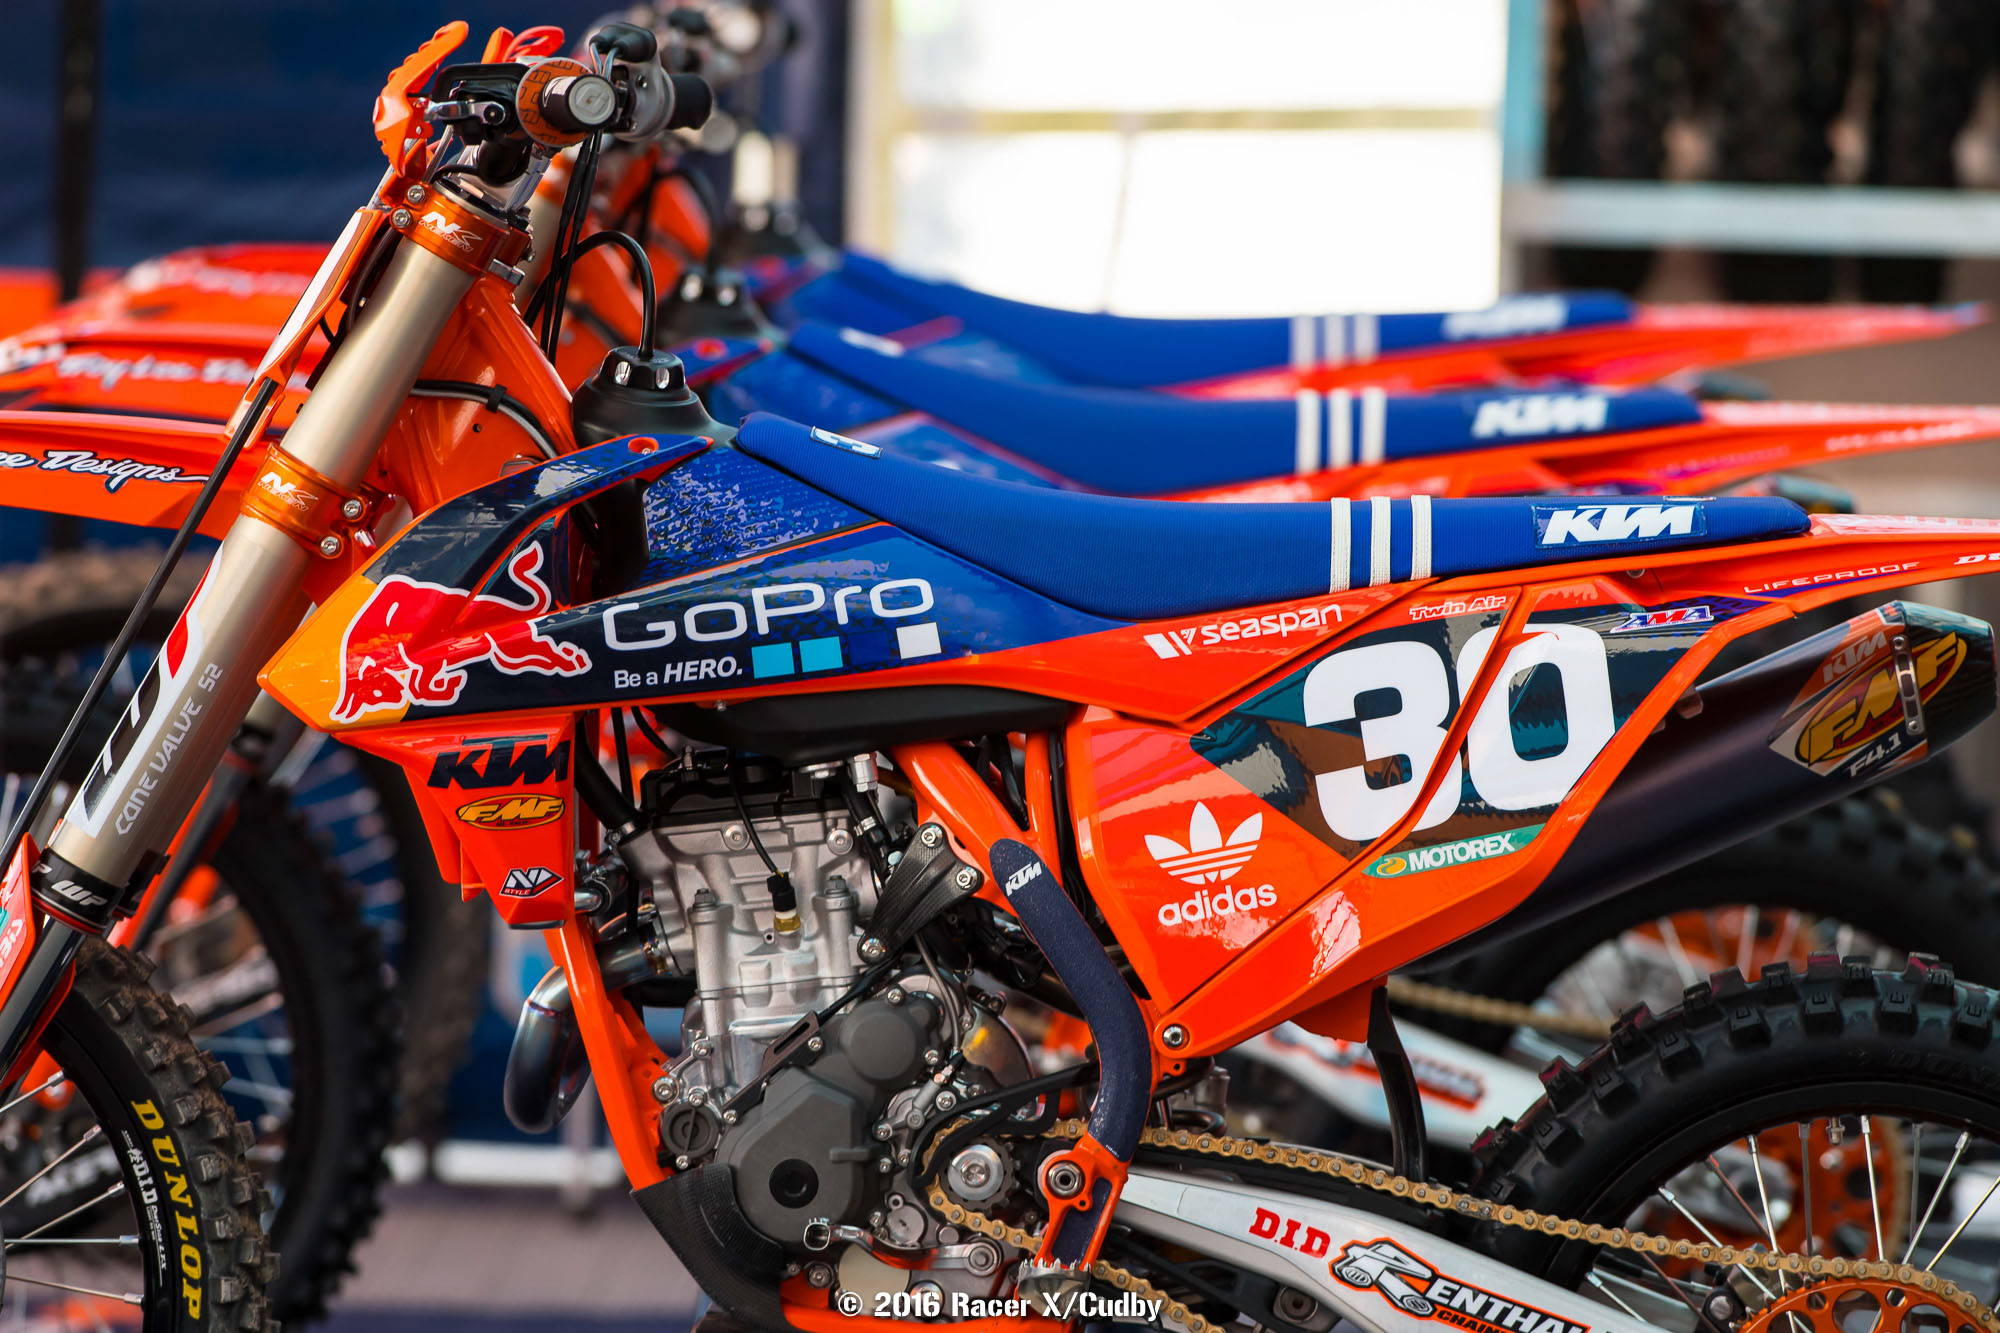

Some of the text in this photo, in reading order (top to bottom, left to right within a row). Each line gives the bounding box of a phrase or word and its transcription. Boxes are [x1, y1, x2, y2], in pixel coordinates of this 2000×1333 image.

[40, 450, 211, 492] Designs
[1542, 504, 1695, 545] KTM
[1743, 561, 1921, 594] LIFEPROOF
[602, 578, 934, 651] GoPro
[1202, 603, 1343, 646] seaspan
[1409, 595, 1507, 621] Twin Air
[614, 656, 743, 689] Be a HERO.
[1822, 631, 1888, 684] KTM
[1807, 631, 1959, 767] FMF
[1303, 623, 1616, 842] 30
[115, 771, 158, 836] CONE
[149, 696, 203, 774] VALVE
[427, 733, 571, 790] KTM
[1850, 731, 1901, 777] F4.1
[459, 796, 564, 823] FMF
[1408, 833, 1516, 871] MOTOREX
[51, 880, 108, 906] WP
[503, 887, 531, 896] STYLE
[1005, 861, 1042, 896] KTM
[1158, 884, 1277, 926] adidas
[131, 1099, 202, 1320] DUNLOP
